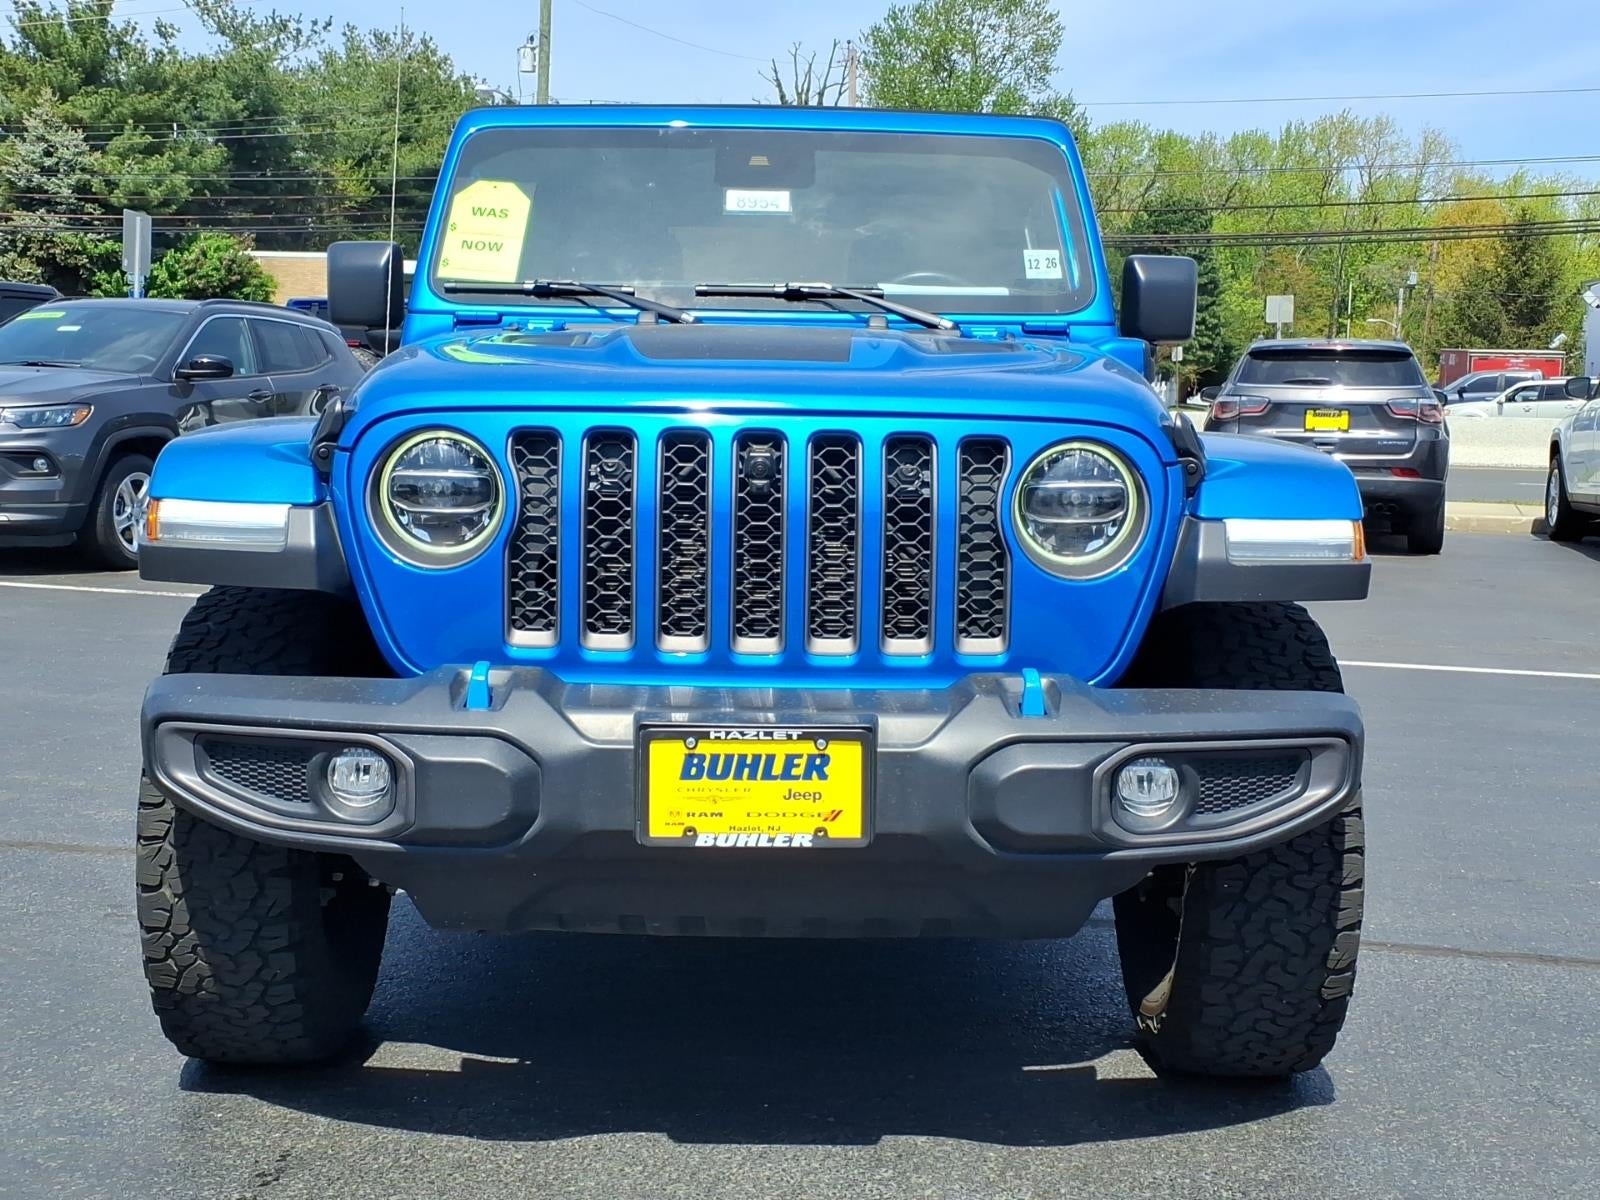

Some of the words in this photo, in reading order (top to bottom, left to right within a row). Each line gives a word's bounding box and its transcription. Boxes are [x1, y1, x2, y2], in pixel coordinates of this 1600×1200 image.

[736, 196, 780, 209] 8954
[471, 206, 510, 219] WAS
[449, 222, 457, 232] $
[461, 240, 504, 252] NOW
[441, 257, 450, 268] $
[1028, 259, 1041, 270] 12
[1045, 257, 1058, 269] 26
[709, 730, 803, 740] HAZLET
[679, 753, 831, 781] BUHLER
[783, 788, 822, 803] Jeep
[694, 833, 813, 847] BUHLER
